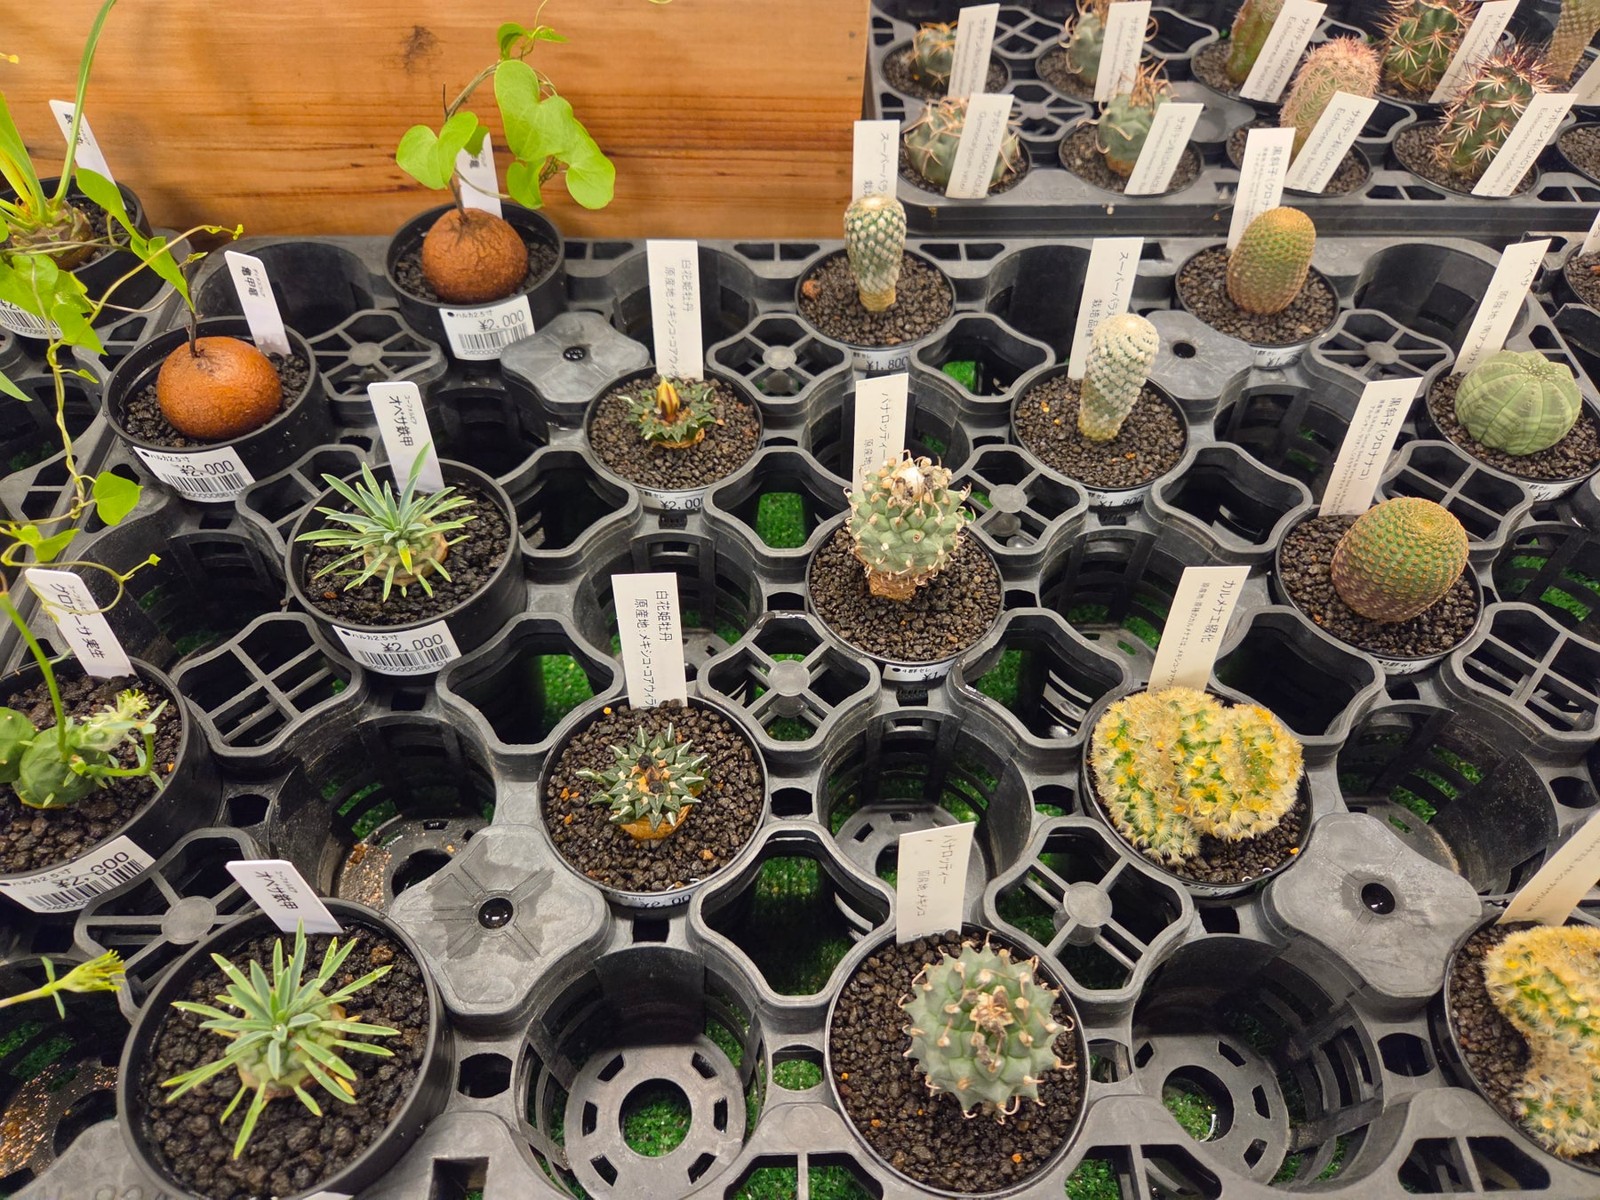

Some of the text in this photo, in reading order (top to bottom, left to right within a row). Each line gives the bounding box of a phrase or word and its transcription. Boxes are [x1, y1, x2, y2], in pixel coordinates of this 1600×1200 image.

[656, 591, 673, 642] 白花姫牡丹
